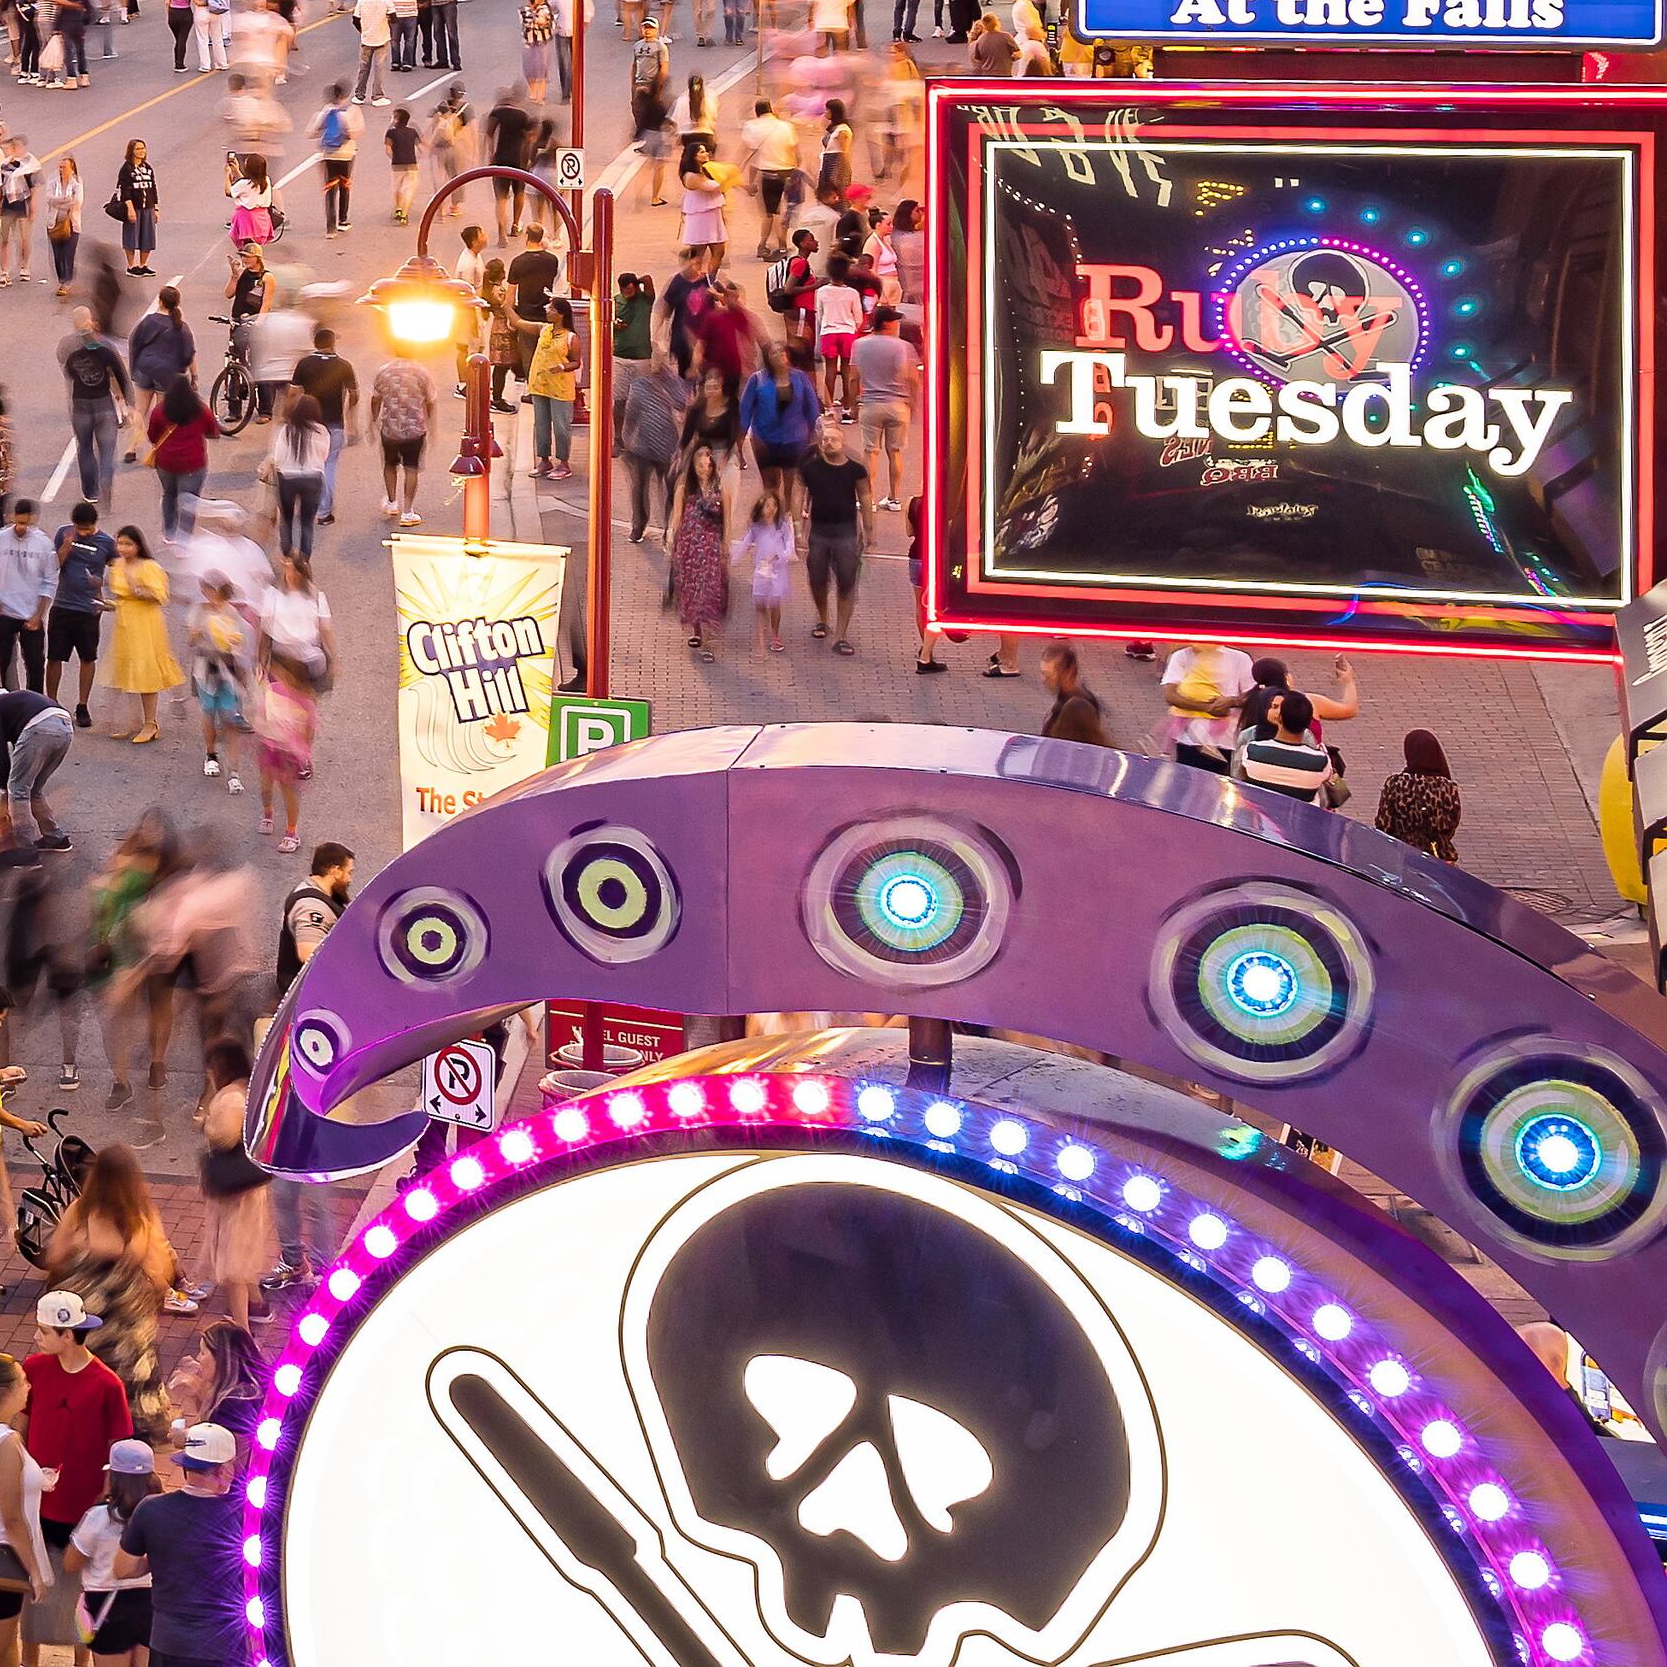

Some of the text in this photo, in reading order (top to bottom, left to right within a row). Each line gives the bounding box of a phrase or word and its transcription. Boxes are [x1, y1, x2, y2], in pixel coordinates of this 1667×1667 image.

[1073, 263, 1405, 380] Ruby
[1039, 349, 1573, 478] Tuesday
[407, 616, 546, 676] Clifton
[447, 665, 531, 724] Hill
[577, 717, 616, 755] P
[416, 787, 456, 815] The
[618, 1032, 661, 1048] GUEST
[636, 1048, 664, 1062] NLY
